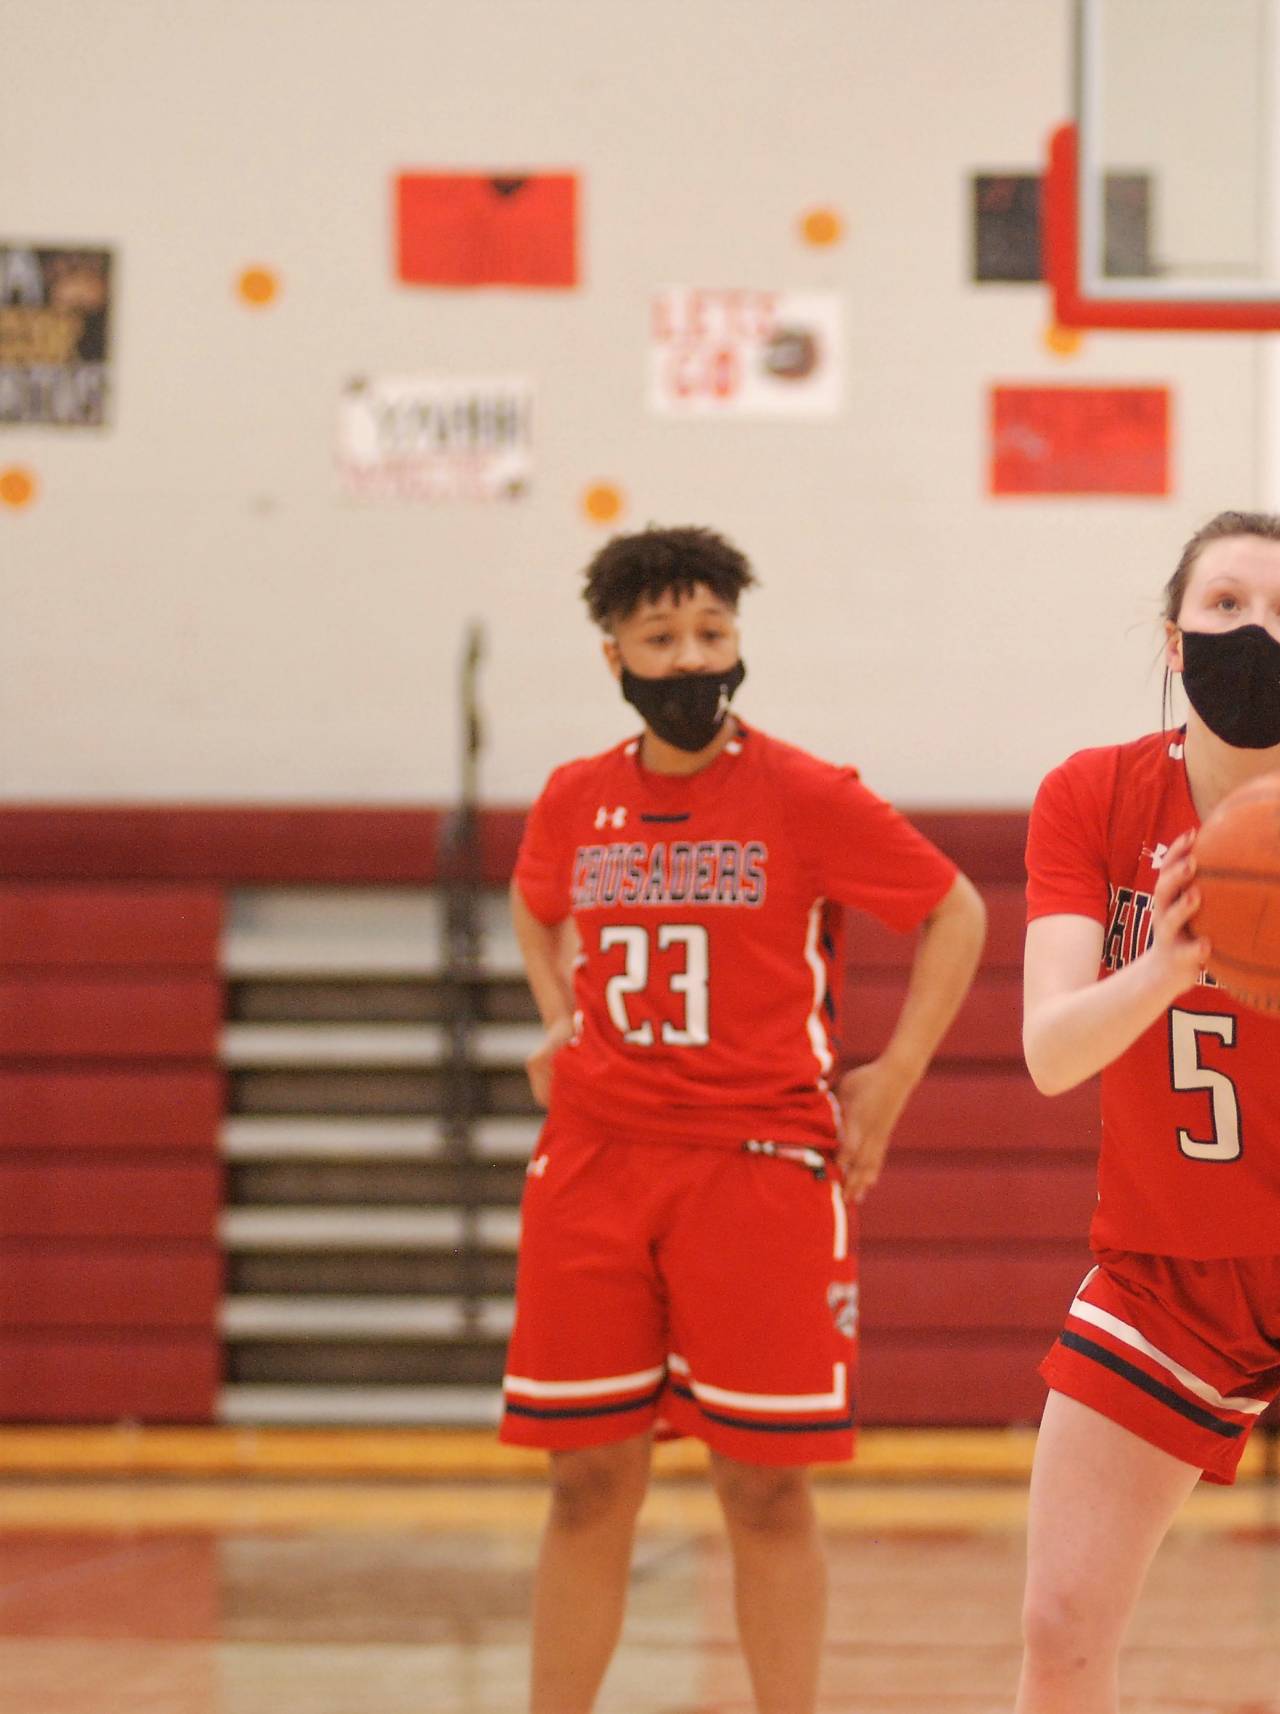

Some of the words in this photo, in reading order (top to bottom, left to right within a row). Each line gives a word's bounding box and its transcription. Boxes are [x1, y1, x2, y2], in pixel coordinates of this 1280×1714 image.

[572, 839, 768, 909] CRUSADERS
[599, 923, 711, 1048] 23
[1167, 1004, 1244, 1163] 5
